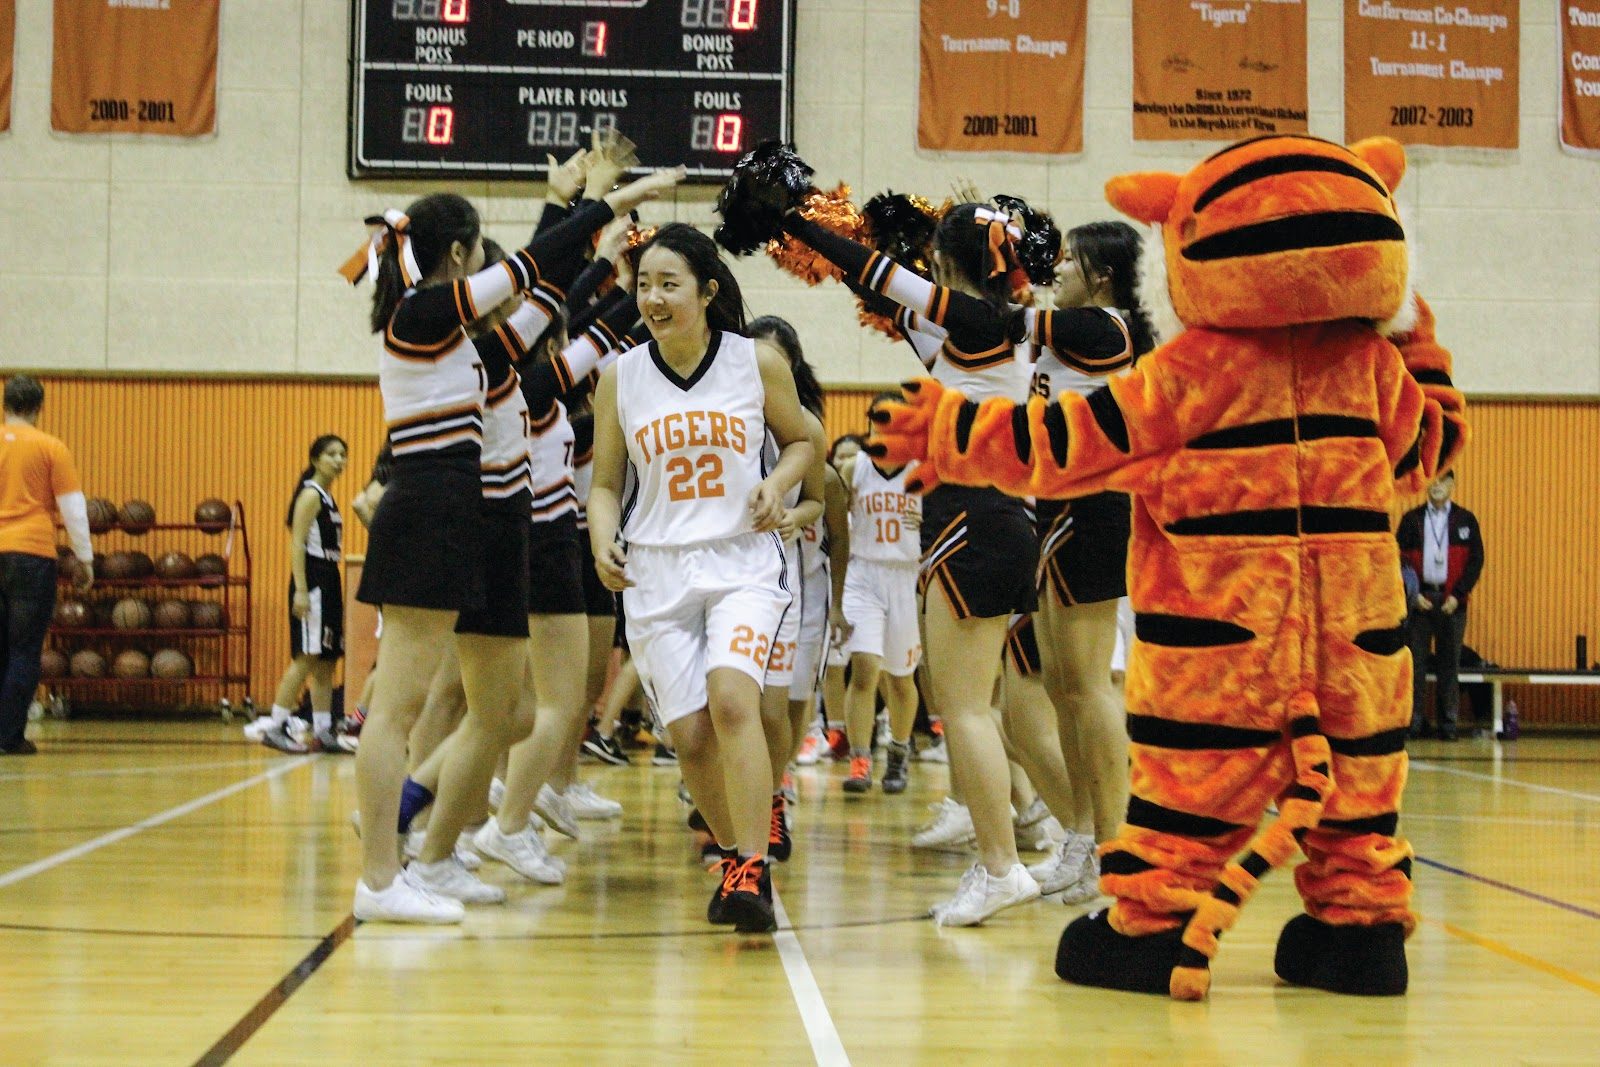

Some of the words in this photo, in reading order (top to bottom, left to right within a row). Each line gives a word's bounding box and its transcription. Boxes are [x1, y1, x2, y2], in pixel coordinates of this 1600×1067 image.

[731, 0, 757, 30] 0
[986, 0, 1020, 18] 9-0
[1359, 0, 1432, 22] Conference
[1568, 6, 1600, 27] Ten
[415, 26, 467, 46] BONUS
[517, 29, 574, 48] PERIOD
[596, 21, 607, 56] 1
[683, 34, 734, 53] BONUS
[415, 46, 453, 64] POSS
[696, 53, 734, 71] POSS
[1450, 60, 1504, 85] Champs
[405, 83, 454, 102] FOULS
[518, 86, 576, 106] PLAYER
[580, 88, 628, 108] FOULS
[694, 91, 742, 110] FOULS
[90, 99, 176, 123] 2000-2001
[1390, 105, 1474, 127] 2002-2003
[427, 106, 454, 145] 0
[714, 113, 742, 152] 0
[963, 114, 1038, 137] 2000-2001
[634, 410, 746, 465] TIGERS
[665, 453, 725, 502] 22
[875, 517, 900, 543] 10
[729, 624, 769, 671] 22
